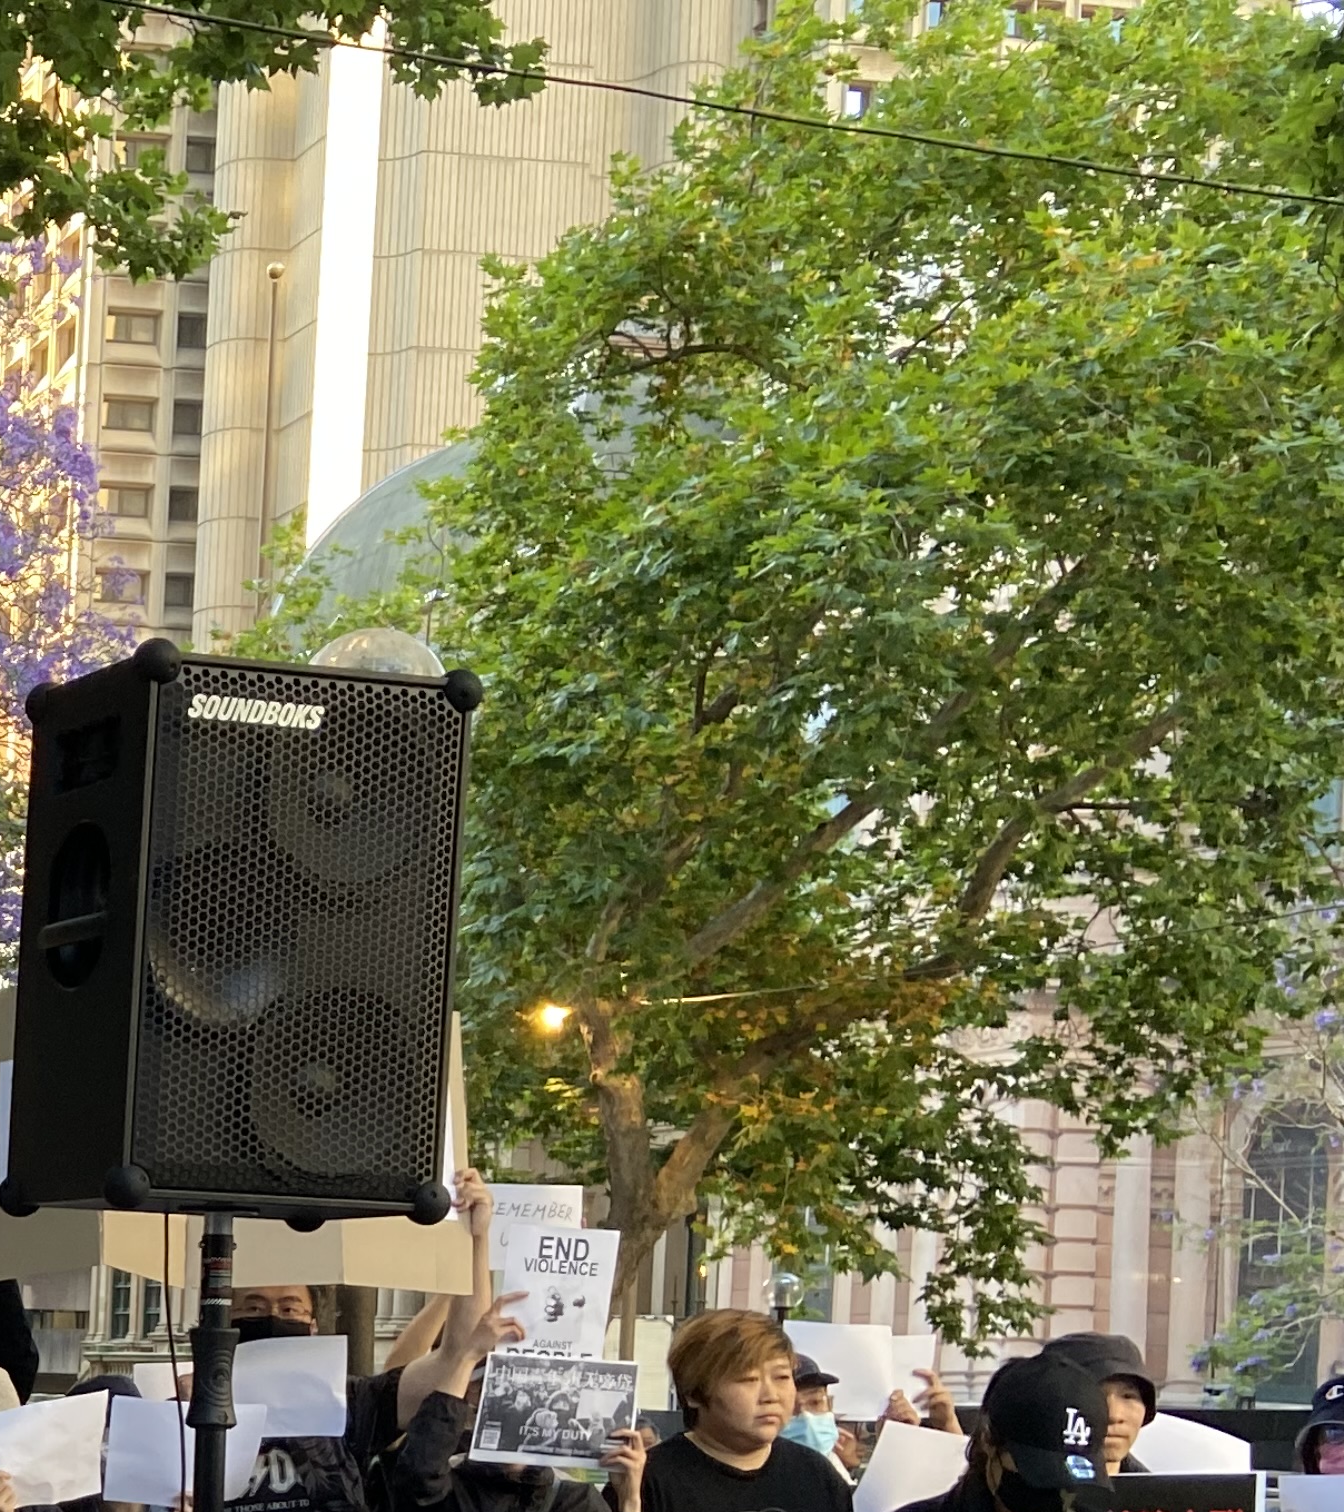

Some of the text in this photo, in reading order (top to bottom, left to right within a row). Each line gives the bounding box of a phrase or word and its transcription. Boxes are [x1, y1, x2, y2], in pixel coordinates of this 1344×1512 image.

[188, 692, 325, 730] SOUNDBOKS
[538, 1236, 590, 1262] END
[524, 1257, 599, 1277] VIOLENCE
[532, 1338, 573, 1350] AGAINST
[542, 1427, 560, 1438] MY
[1063, 1407, 1091, 1446] LA
